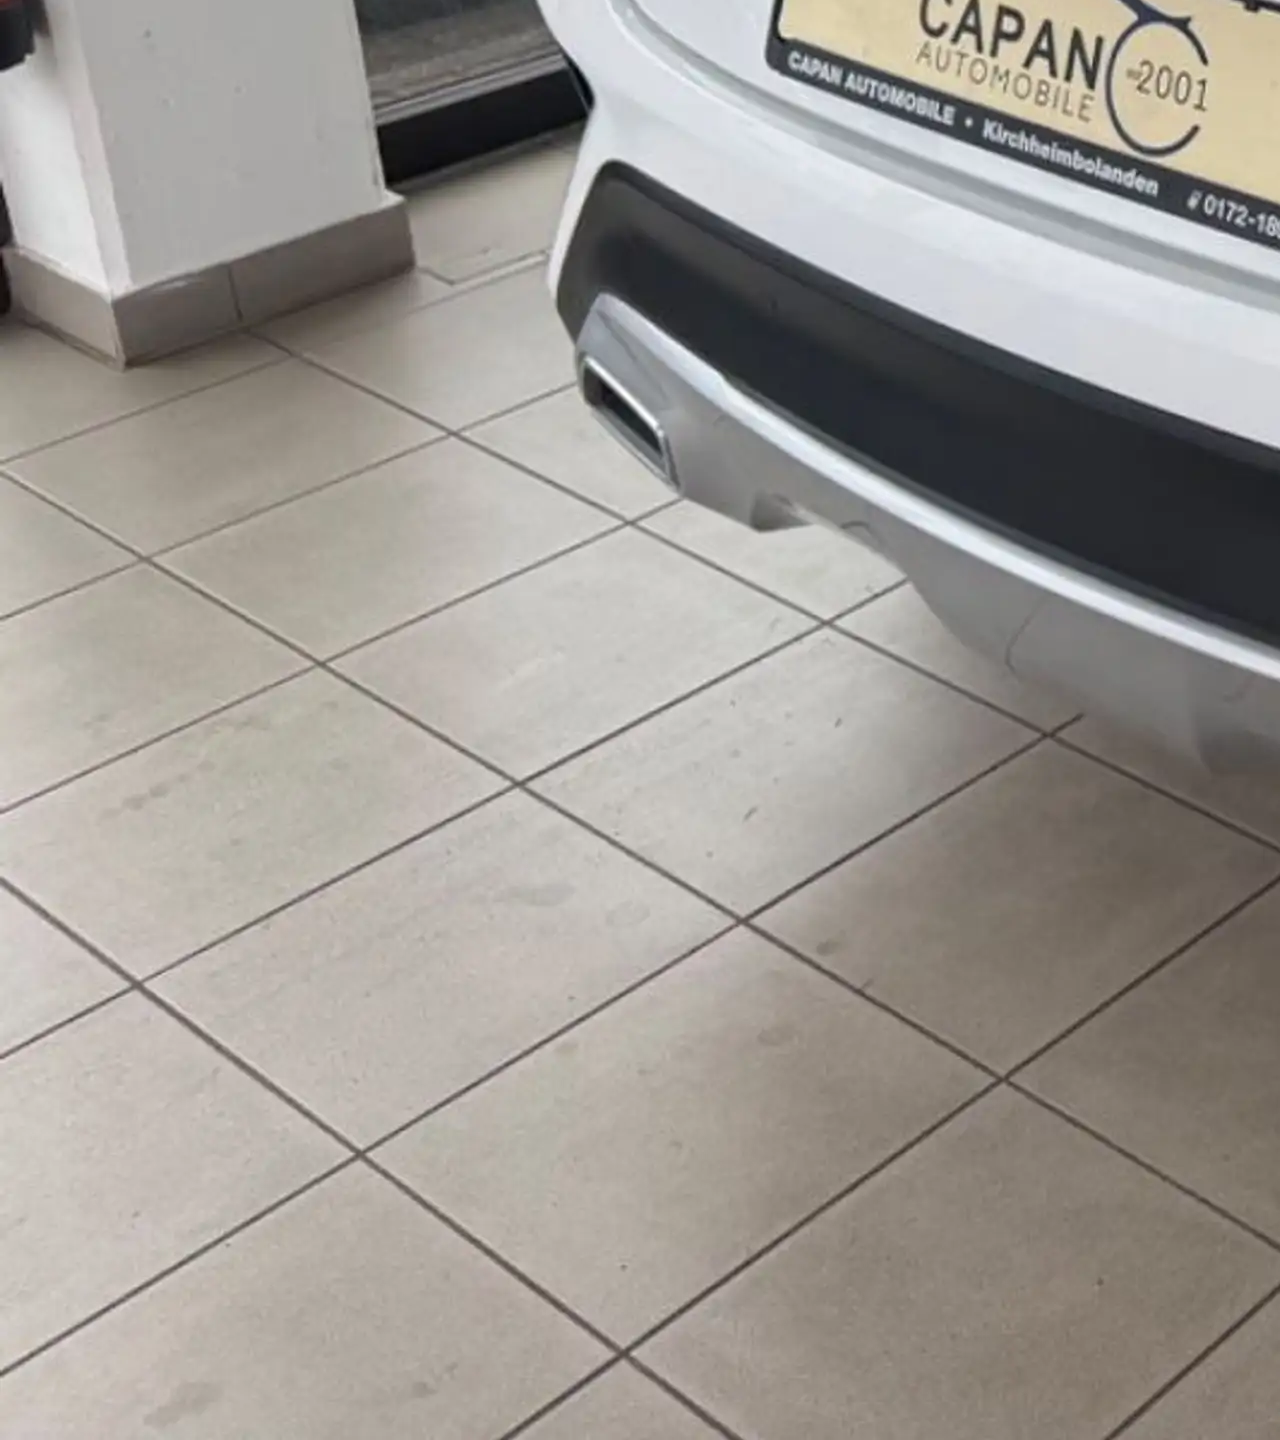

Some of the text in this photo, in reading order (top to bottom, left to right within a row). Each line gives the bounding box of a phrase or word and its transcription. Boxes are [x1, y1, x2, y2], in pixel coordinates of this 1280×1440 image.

[787, 49, 842, 86] CAPAN
[844, 72, 957, 126] AUTOMOBILE
[982, 117, 1160, 197] Kirchheimbolanden
[915, 40, 1096, 123] AUTOMOBILE
[1136, 59, 1209, 112] 2001
